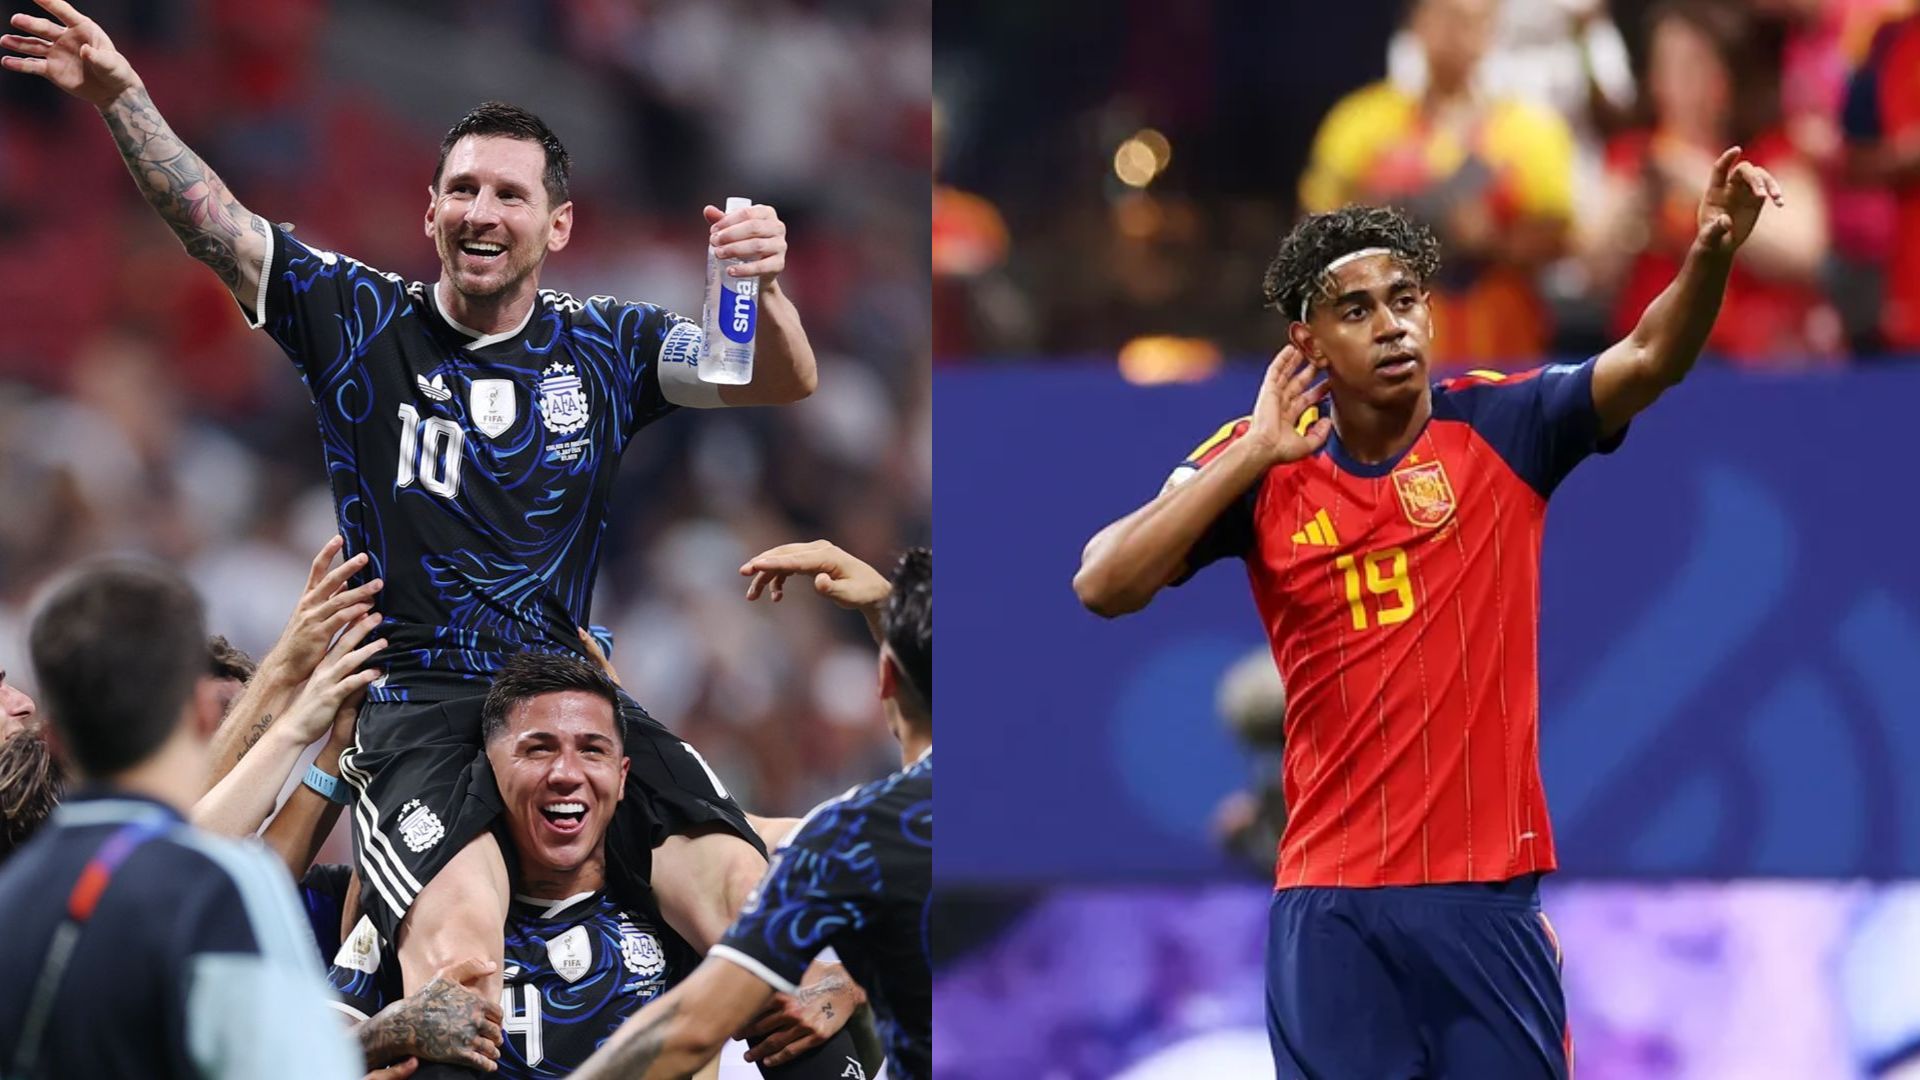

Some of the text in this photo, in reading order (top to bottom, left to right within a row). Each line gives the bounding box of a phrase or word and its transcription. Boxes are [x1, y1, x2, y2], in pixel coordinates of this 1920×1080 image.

[733, 281, 751, 333] sma
[551, 391, 579, 417] AFA
[398, 403, 465, 499] 10
[1336, 547, 1415, 630] 19
[632, 935, 656, 959] AFA
[502, 983, 544, 1068] 4
